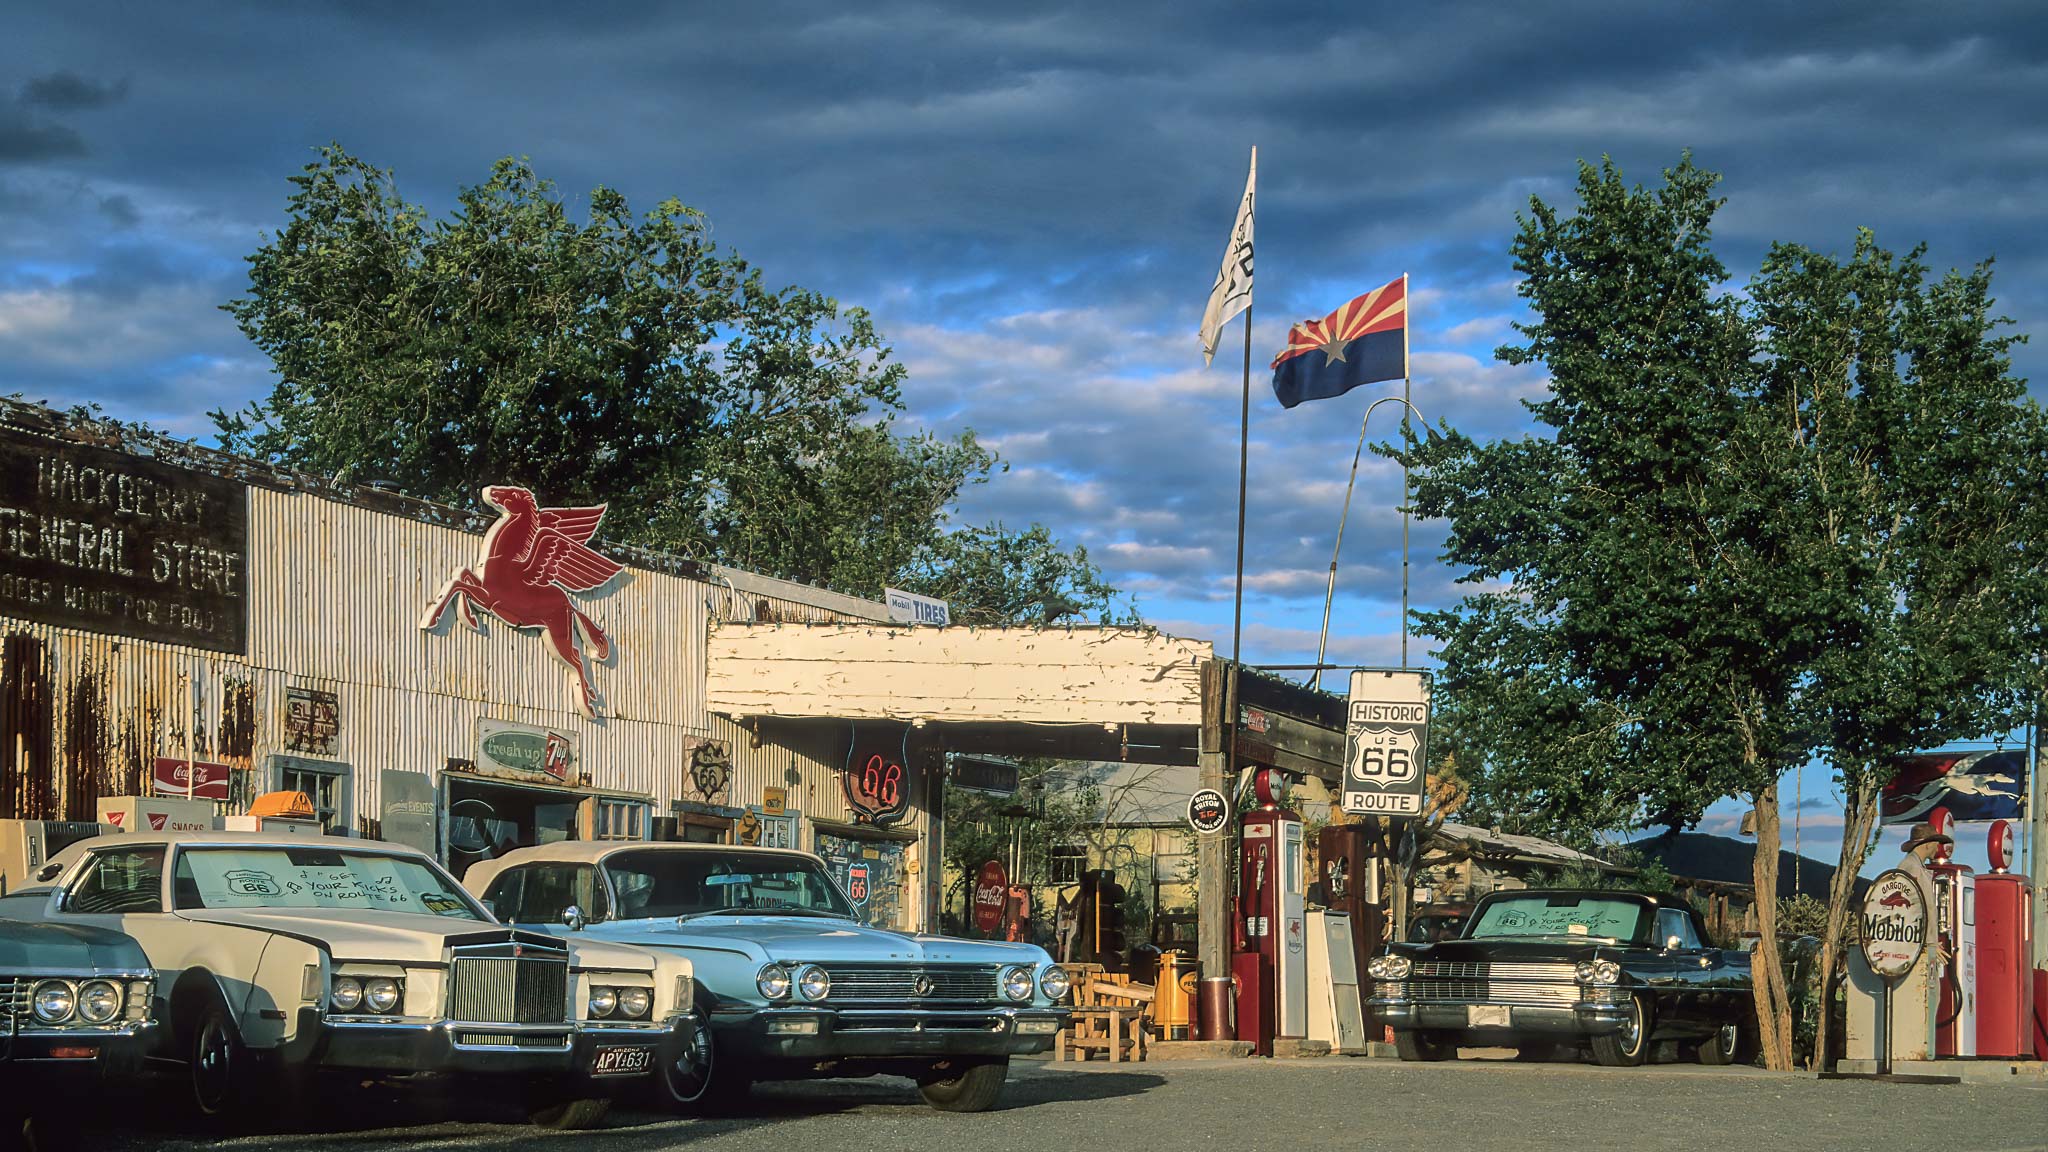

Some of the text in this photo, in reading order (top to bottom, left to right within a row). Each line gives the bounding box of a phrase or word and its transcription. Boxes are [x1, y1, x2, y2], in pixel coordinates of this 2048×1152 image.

[892, 598, 946, 624] Mobil TIRES
[1355, 704, 1424, 722] HISTORIC
[1362, 747, 1409, 777] 66
[173, 765, 209, 783] CocaCola
[700, 768, 718, 788] 66
[864, 755, 900, 804] 66
[1194, 800, 1220, 811] TRITON
[1195, 794, 1217, 803] ROYAL
[1353, 794, 1411, 810] ROUTE
[329, 872, 358, 881] GET
[305, 881, 398, 894] YOUR KICKS
[338, 890, 386, 901] ROUTE
[389, 893, 408, 903] 66
[851, 880, 866, 899] 66
[1863, 912, 1923, 944] Mobiloil
[596, 1051, 650, 1069] APY 631
